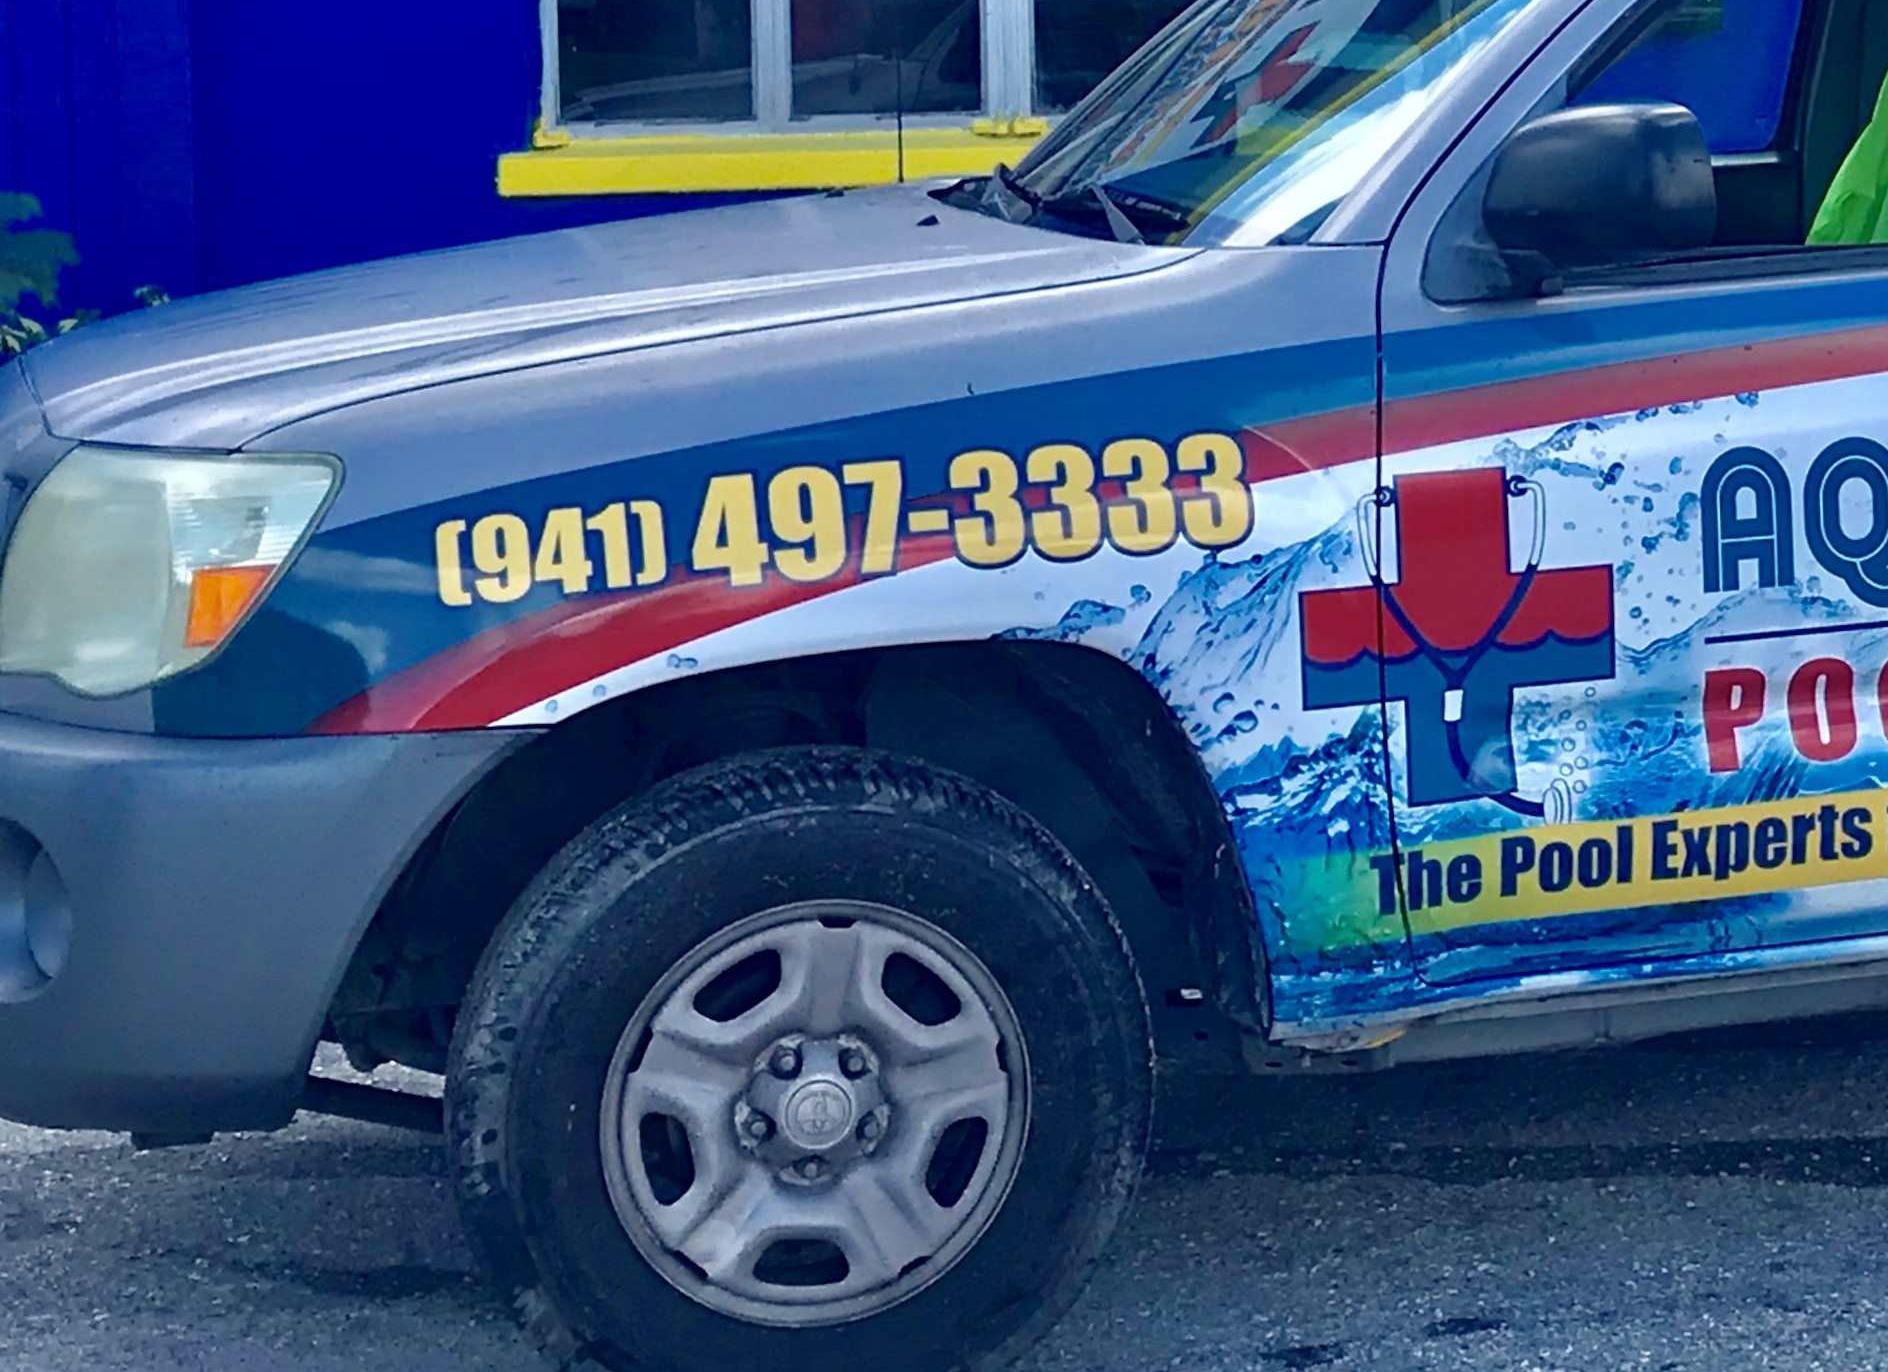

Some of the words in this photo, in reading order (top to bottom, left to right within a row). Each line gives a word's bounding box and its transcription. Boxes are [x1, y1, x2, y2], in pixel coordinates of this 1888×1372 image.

[433, 499, 666, 607] (941)
[690, 431, 1256, 591] 497-3333
[1369, 849, 1482, 916] The
[1499, 825, 1634, 898] Pool
[1651, 804, 1873, 882] Experts
